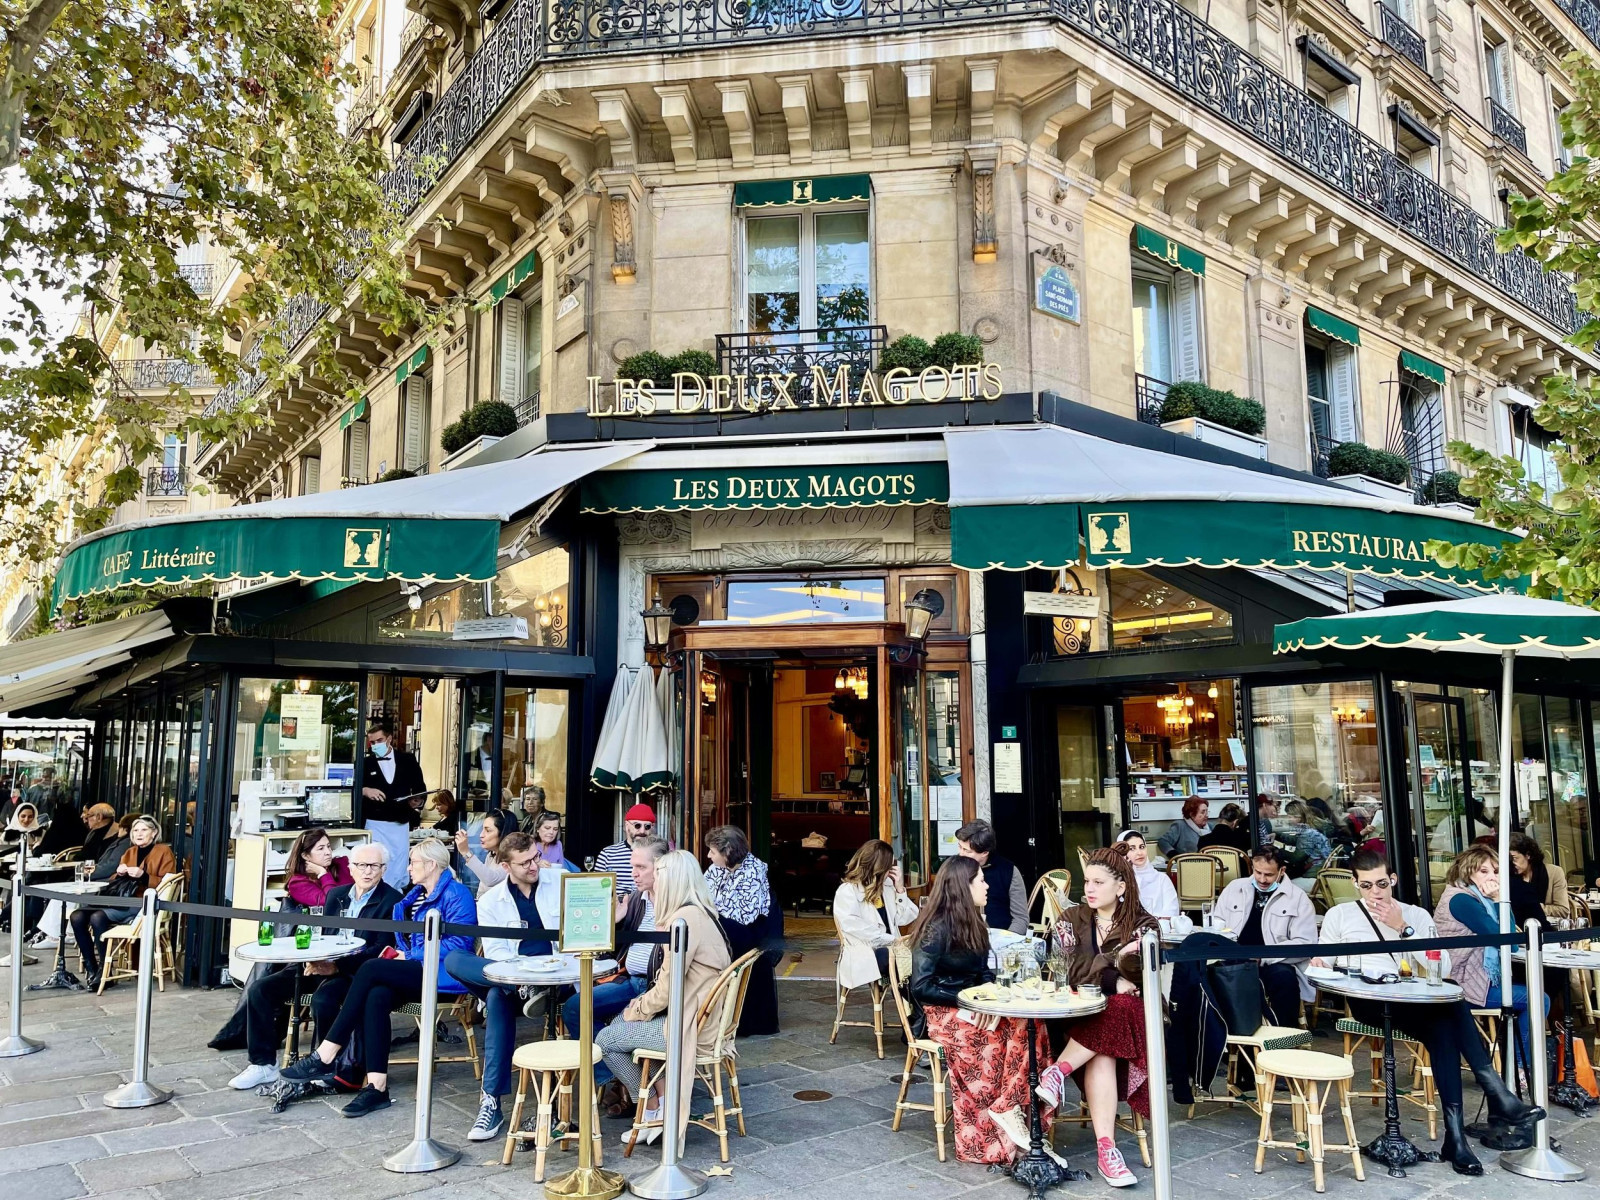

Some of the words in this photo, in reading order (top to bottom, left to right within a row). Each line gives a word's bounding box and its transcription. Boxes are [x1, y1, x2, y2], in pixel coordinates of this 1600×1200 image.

[1052, 284, 1066, 295] PLACE
[1049, 300, 1058, 308] DES
[586, 376, 656, 417] LES
[670, 371, 799, 414] DEUX
[809, 362, 1003, 407] MAGOTS
[673, 478, 719, 500] LES
[727, 477, 800, 499] DEUX
[807, 475, 916, 498] MAGOTS
[103, 551, 132, 576] CAFE
[140, 545, 216, 570] Littéraire
